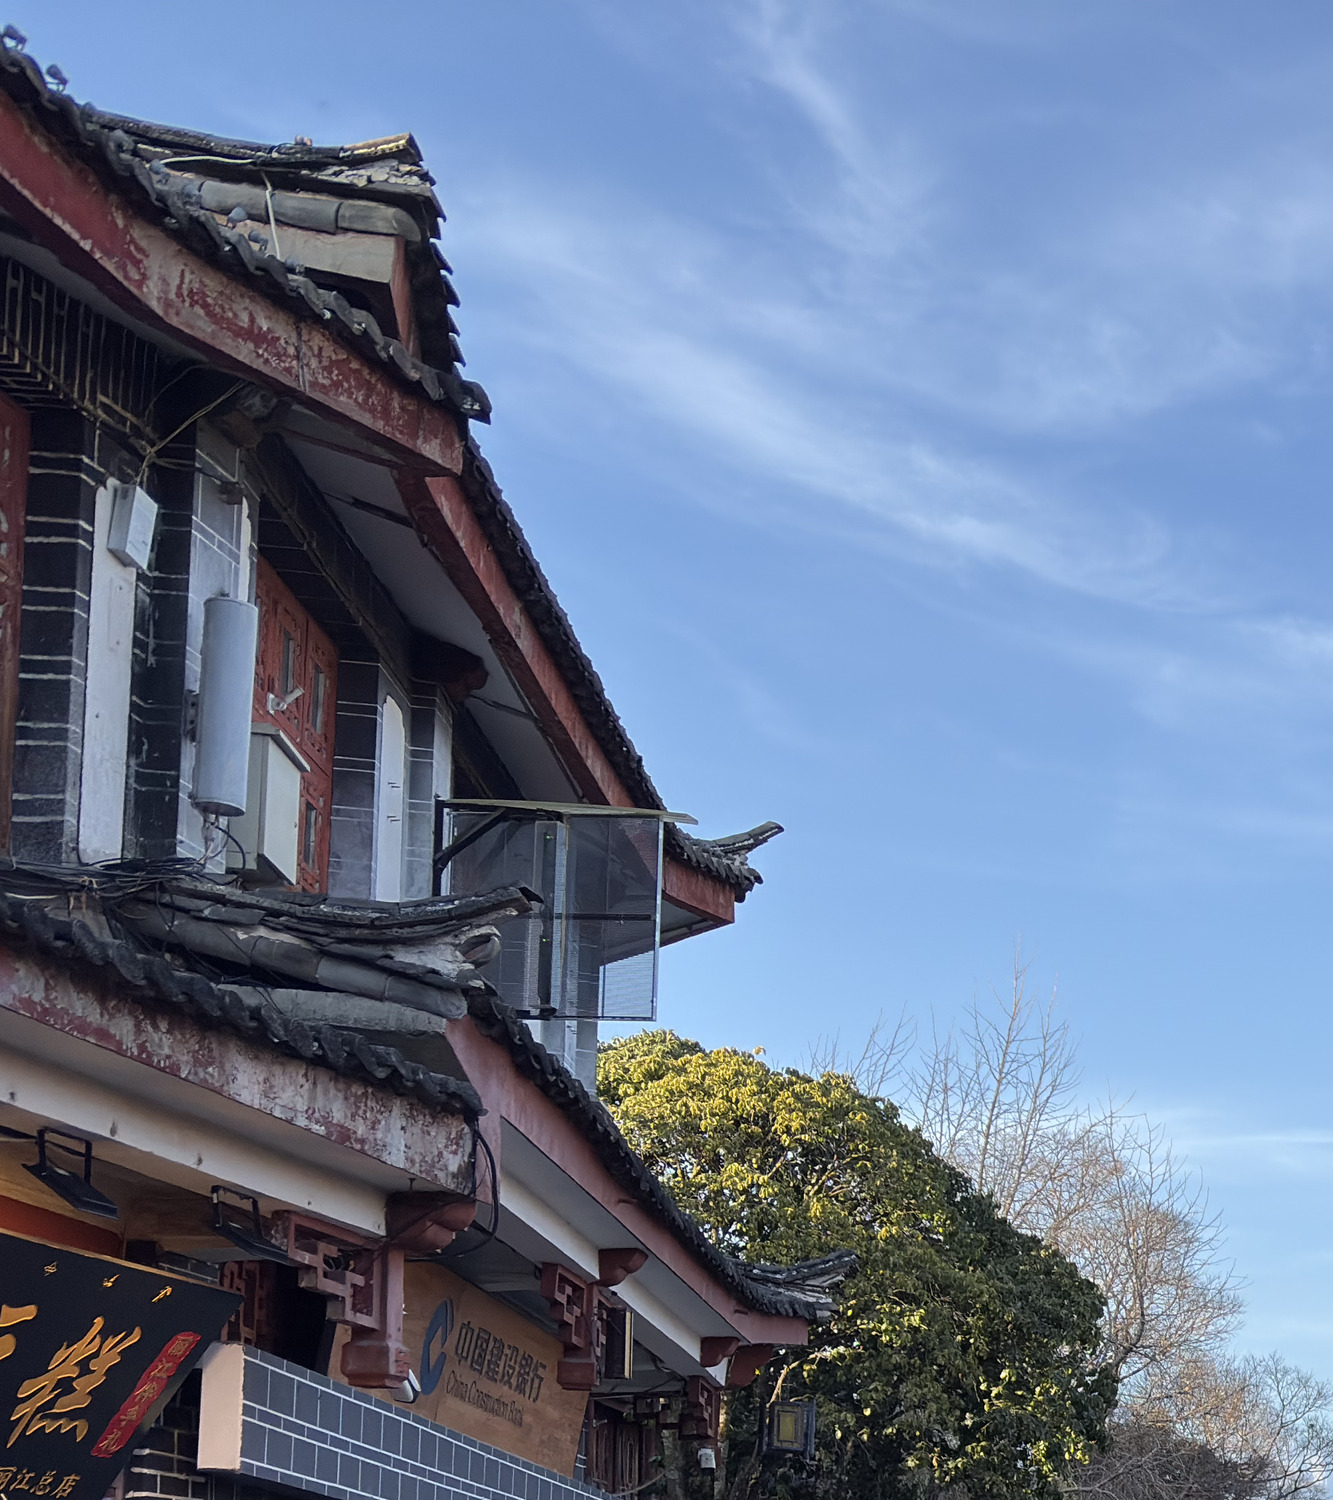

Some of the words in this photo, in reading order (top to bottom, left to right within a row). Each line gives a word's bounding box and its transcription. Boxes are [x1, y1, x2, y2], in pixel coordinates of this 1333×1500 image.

[446, 1370, 469, 1402] China
[455, 1321, 547, 1403] 中国建设银行
